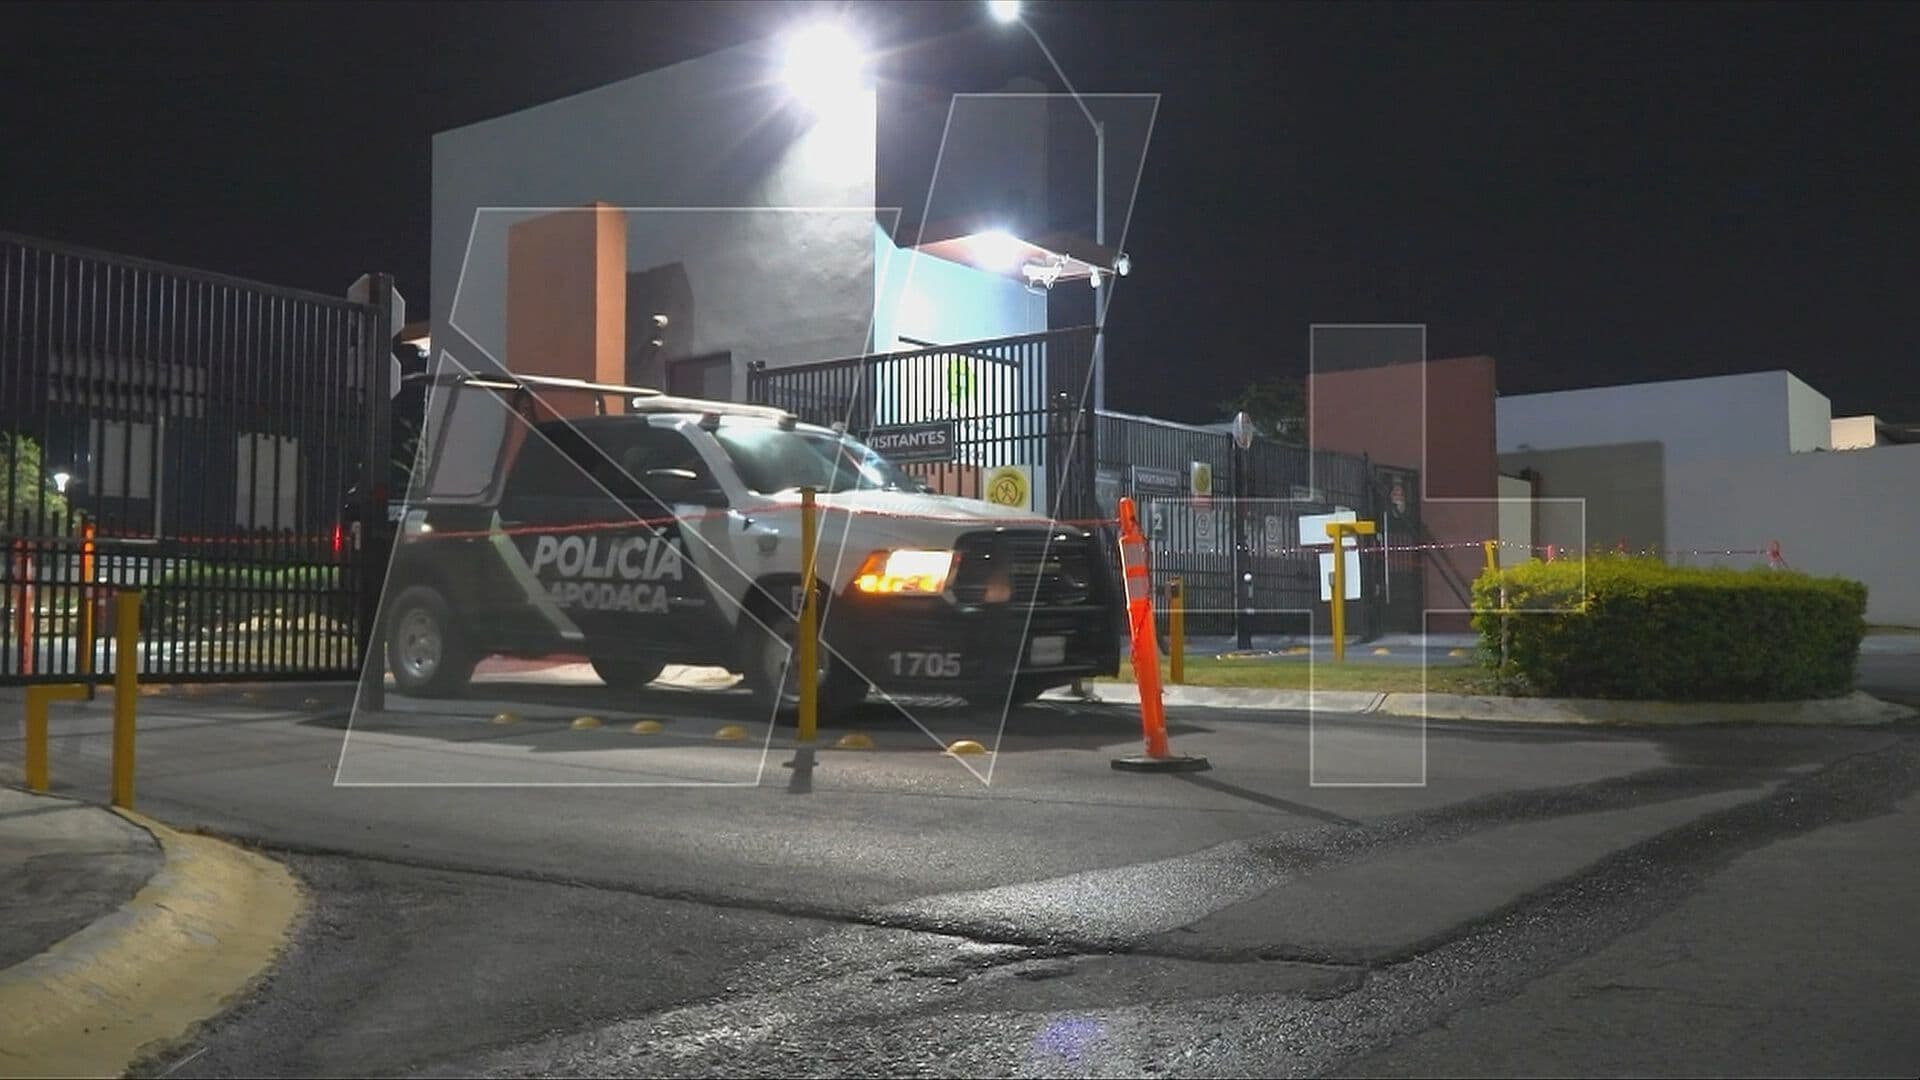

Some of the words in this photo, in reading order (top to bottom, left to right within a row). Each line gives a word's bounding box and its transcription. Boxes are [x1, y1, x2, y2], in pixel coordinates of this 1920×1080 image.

[866, 430, 946, 450] VISITANTES
[533, 528, 683, 581] POLICÍA
[547, 581, 669, 614] APODACA
[889, 652, 961, 677] 1705
